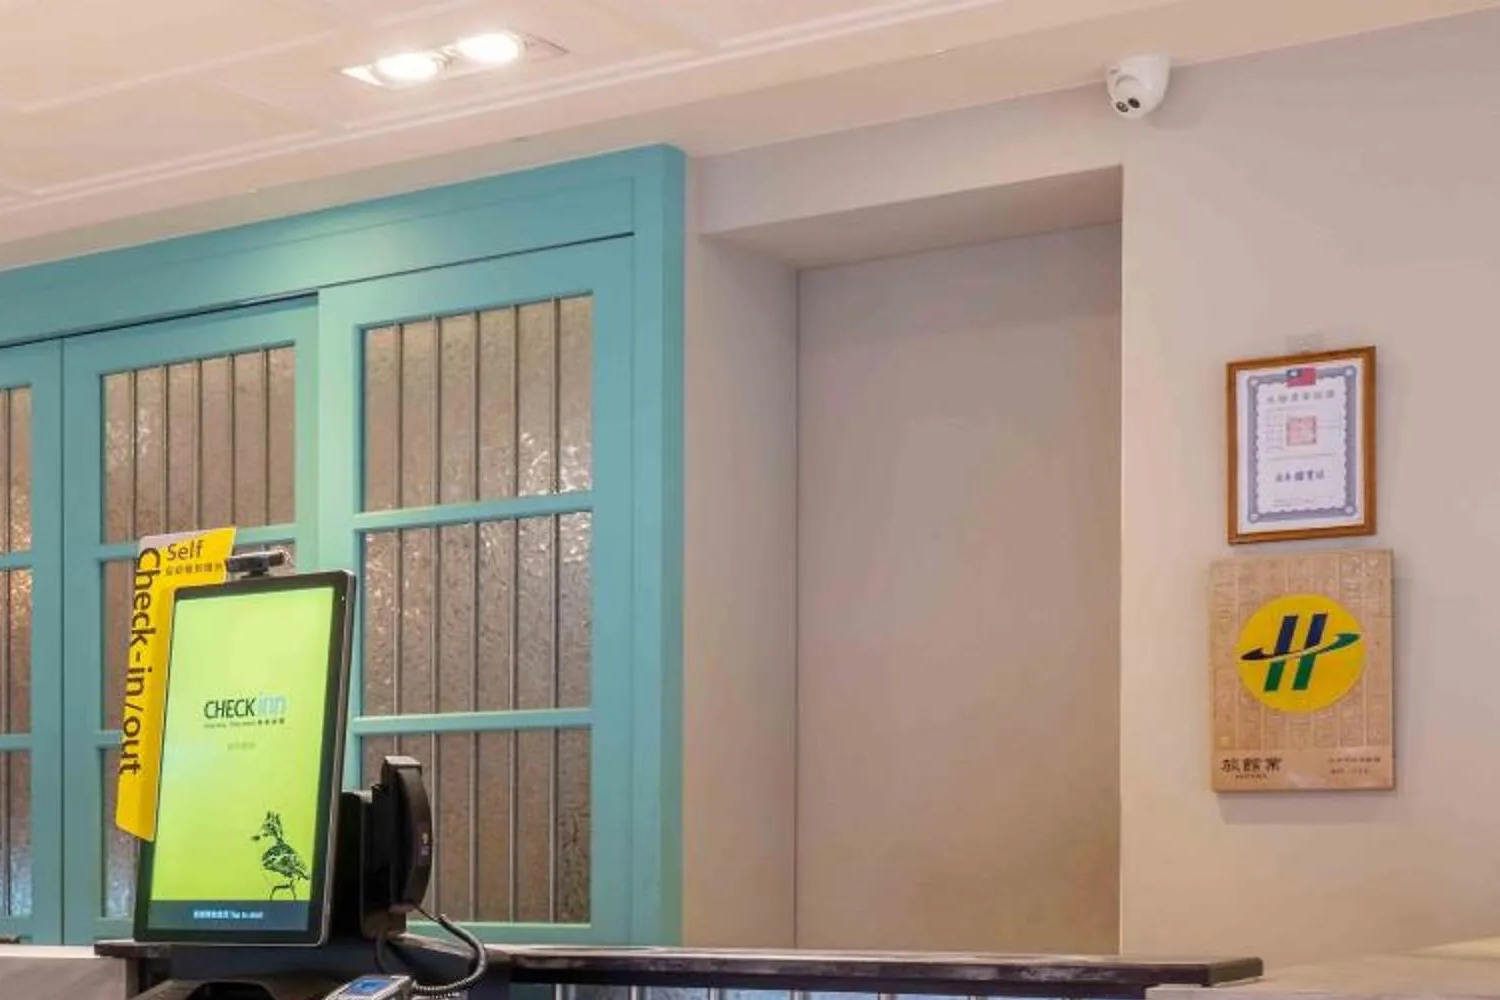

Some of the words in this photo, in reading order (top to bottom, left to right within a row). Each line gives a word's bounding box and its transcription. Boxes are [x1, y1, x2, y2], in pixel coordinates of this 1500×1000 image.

[167, 540, 205, 561] Self
[118, 547, 161, 776] Check-in/out
[204, 697, 256, 720] CHECK
